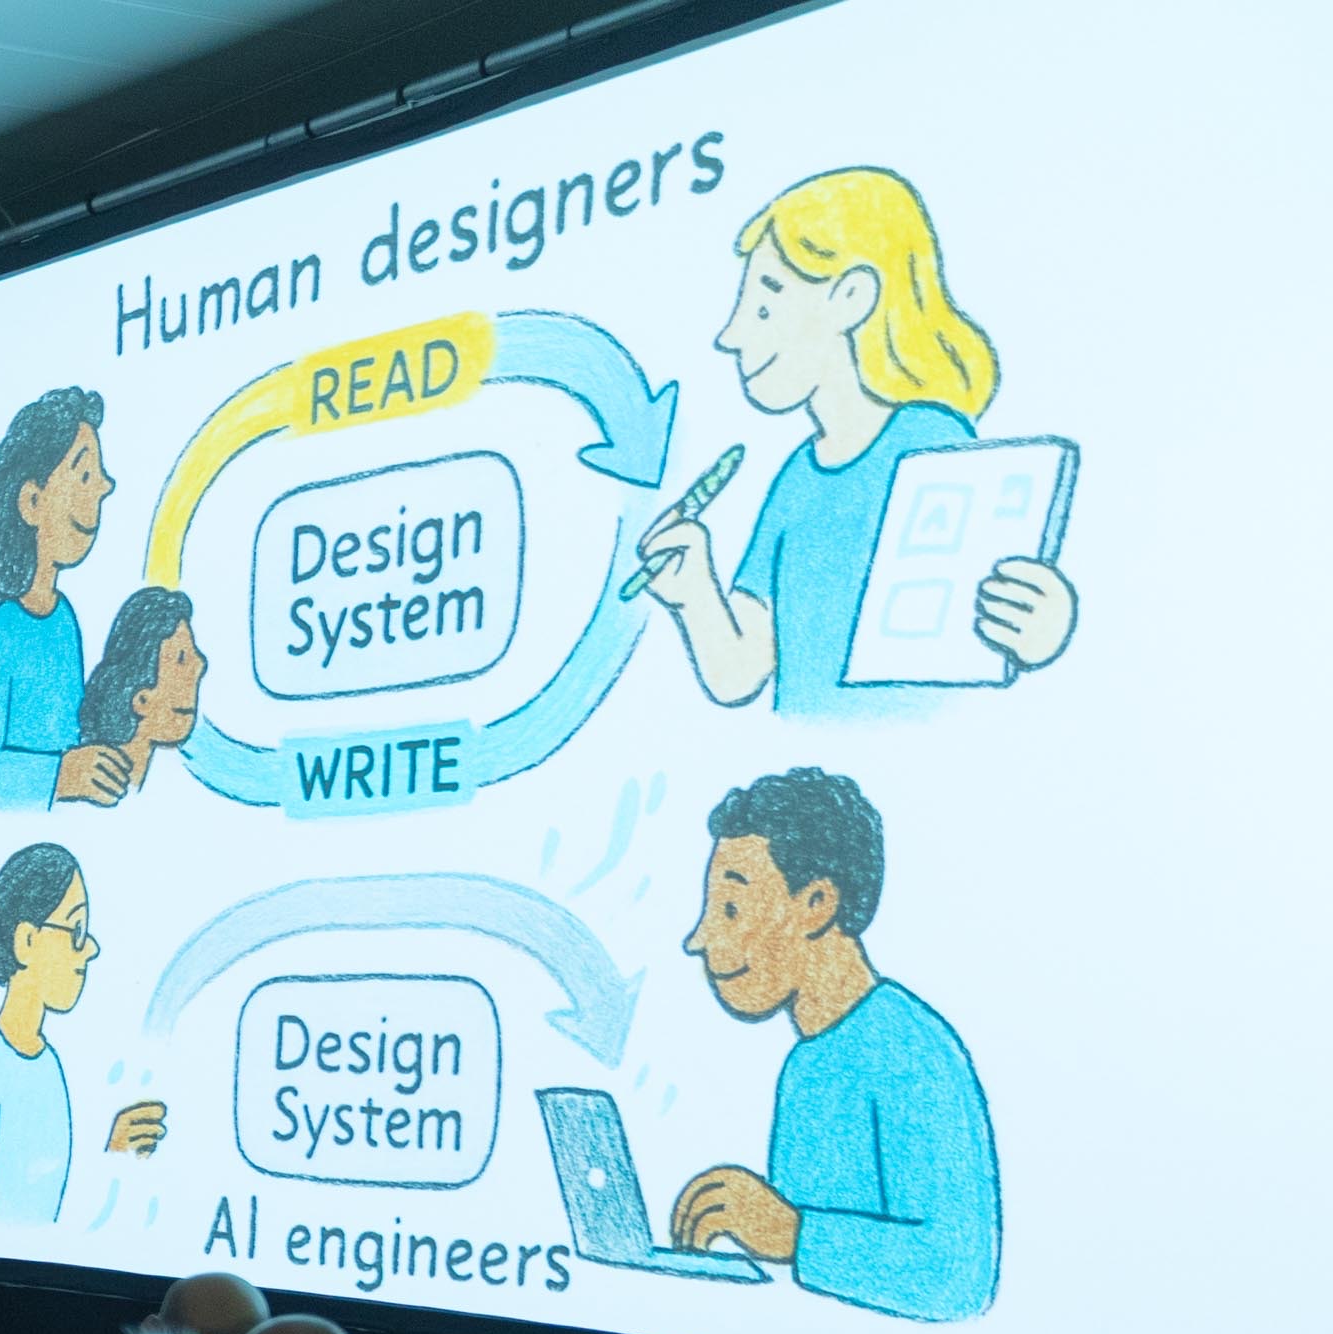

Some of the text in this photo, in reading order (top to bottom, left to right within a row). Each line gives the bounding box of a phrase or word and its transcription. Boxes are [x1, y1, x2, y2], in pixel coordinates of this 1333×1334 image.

[116, 129, 725, 356] Human designers
[310, 340, 459, 425] READ
[290, 504, 482, 585] Design
[287, 585, 484, 668] System
[297, 737, 460, 801] WRITE
[275, 1014, 462, 1094] Design
[272, 1086, 463, 1158] System
[204, 1195, 573, 1292] AI engineers
